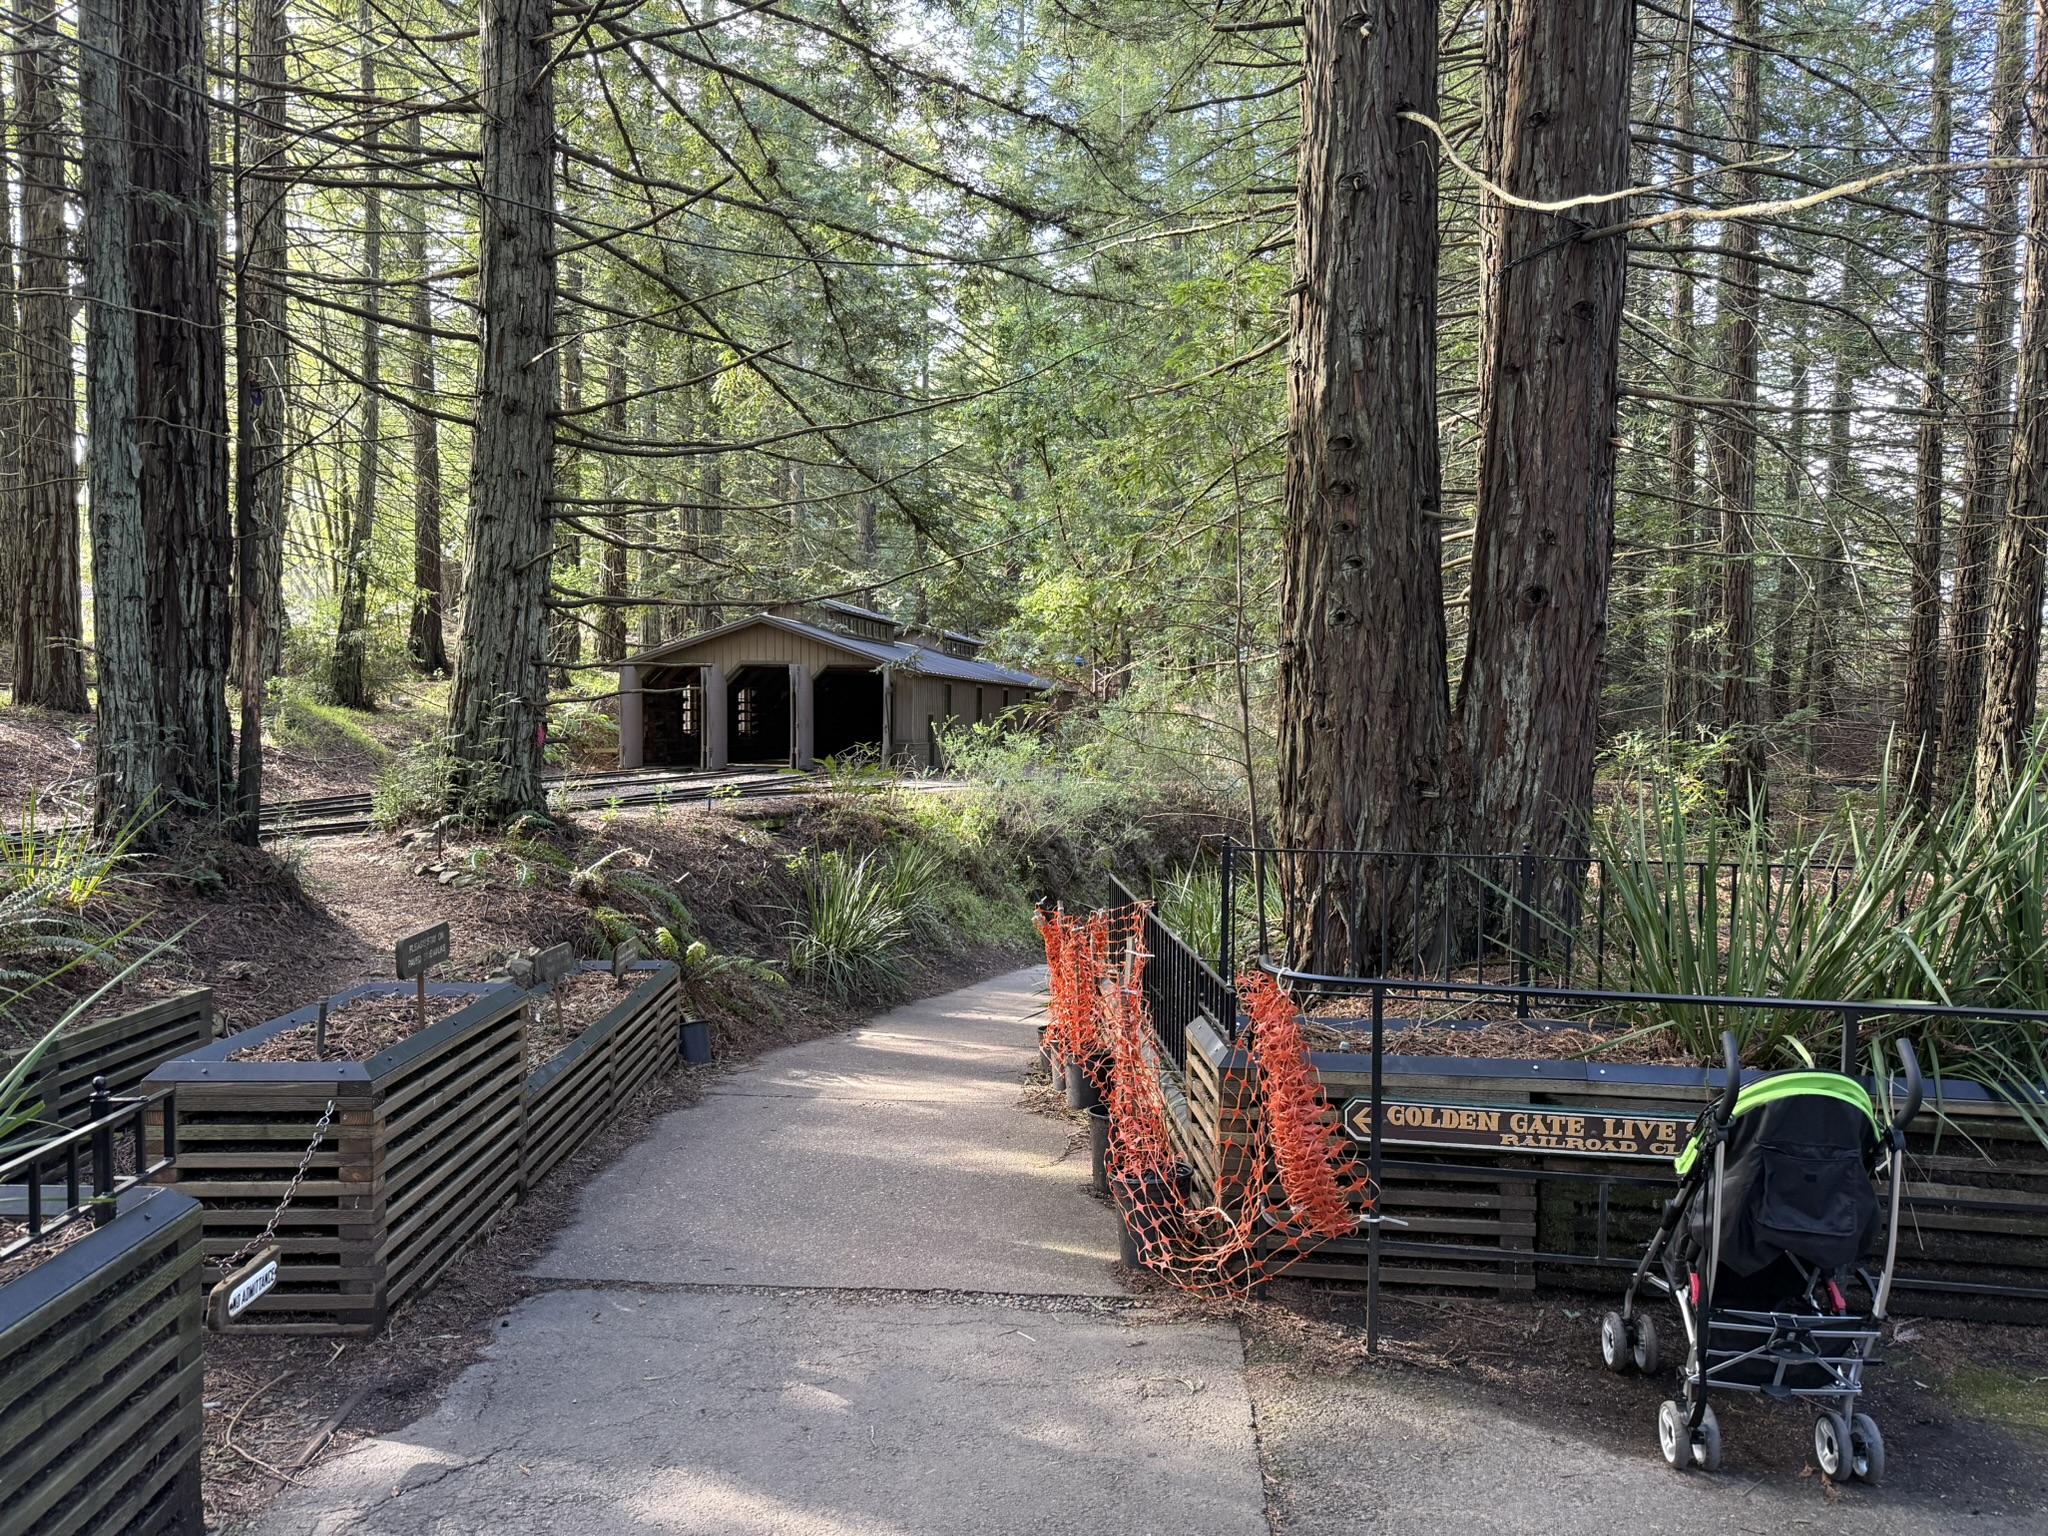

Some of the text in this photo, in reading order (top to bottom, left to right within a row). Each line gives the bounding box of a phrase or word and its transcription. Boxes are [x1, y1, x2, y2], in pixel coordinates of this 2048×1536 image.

[409, 938, 427, 954] PLEASE
[437, 931, 444, 941] ON
[408, 955, 422, 968] PAVED
[1387, 1105, 1501, 1132] GOLDEN
[1510, 1113, 1585, 1137] GATE
[1603, 1118, 1677, 1142] LIVE
[1500, 1133, 1681, 1155] RAILROAD CL
[233, 1267, 276, 1311] NO ADMITTANCE
